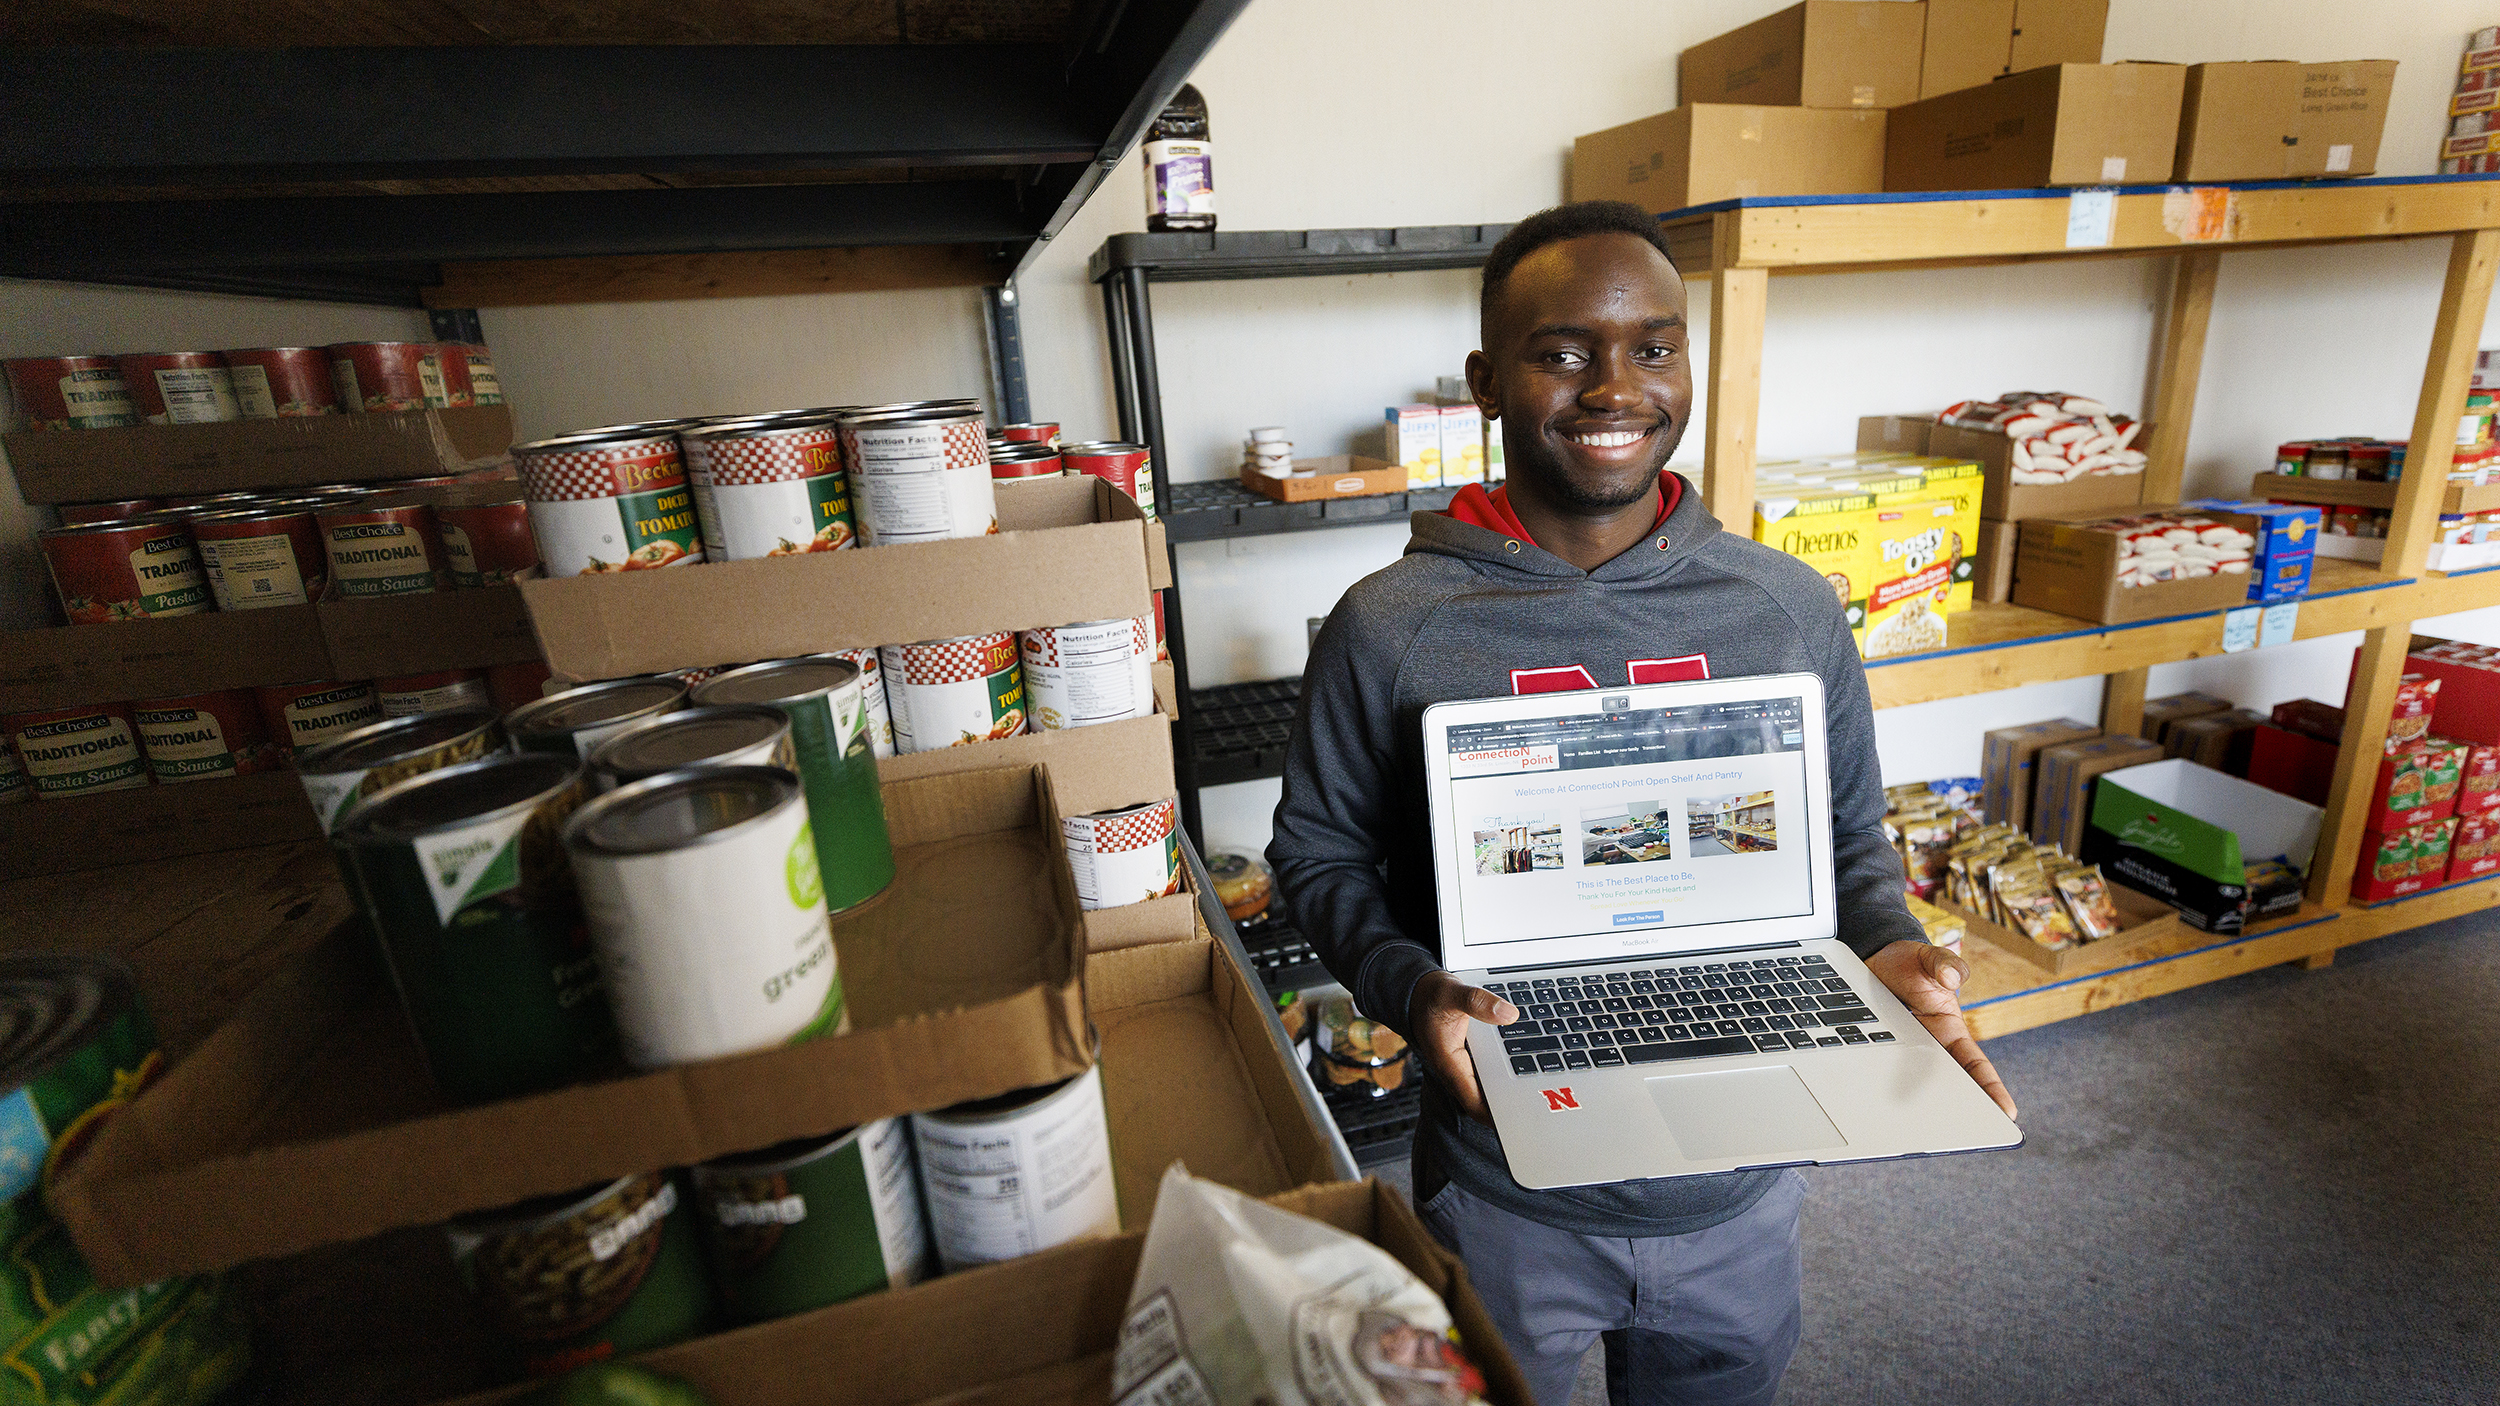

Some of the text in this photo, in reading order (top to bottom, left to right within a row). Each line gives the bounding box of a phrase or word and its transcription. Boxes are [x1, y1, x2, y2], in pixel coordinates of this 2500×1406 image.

[1402, 420, 1437, 433] JIFFY
[1444, 418, 1477, 432] JIFFY
[862, 435, 938, 446] Nutrition Facts
[1898, 478, 1921, 491] SIZE
[1796, 496, 1870, 515] FAMILY SIZE
[333, 524, 402, 540] Best Choice
[147, 539, 171, 553] Best
[1880, 527, 1946, 562] Toasty
[332, 544, 421, 566] TRADITIONAL
[382, 576, 427, 592] Sauce
[156, 591, 197, 609] Pasta
[1062, 628, 1128, 643] Nutrition Facts
[1122, 650, 1131, 658] 25
[1065, 659, 1093, 667] Calories
[298, 687, 367, 708] Best Choice
[151, 711, 194, 723] Choice
[26, 717, 107, 738] Best Choice
[23, 734, 129, 762] TRADITIONAL
[1459, 747, 1531, 762] ConnectioN
[177, 759, 223, 774] Sauce
[1522, 754, 1554, 769] point
[38, 765, 136, 791] Pasta Sauce
[1515, 770, 1743, 797] Welcome At ConnectioN Point Open Shelf And Pantry
[1483, 813, 1546, 828] Thank you!
[1083, 844, 1092, 852] 25
[1576, 871, 1696, 889] This is The Best Place to Be,
[1577, 884, 1696, 901] Thank You For Your Kind Heart and
[1590, 902, 1612, 911] Spread
[1613, 901, 1627, 909] Love
[1628, 898, 1661, 907] Whenever
[1622, 939, 1650, 947] MacBook
[1537, 1086, 1583, 1113] N
